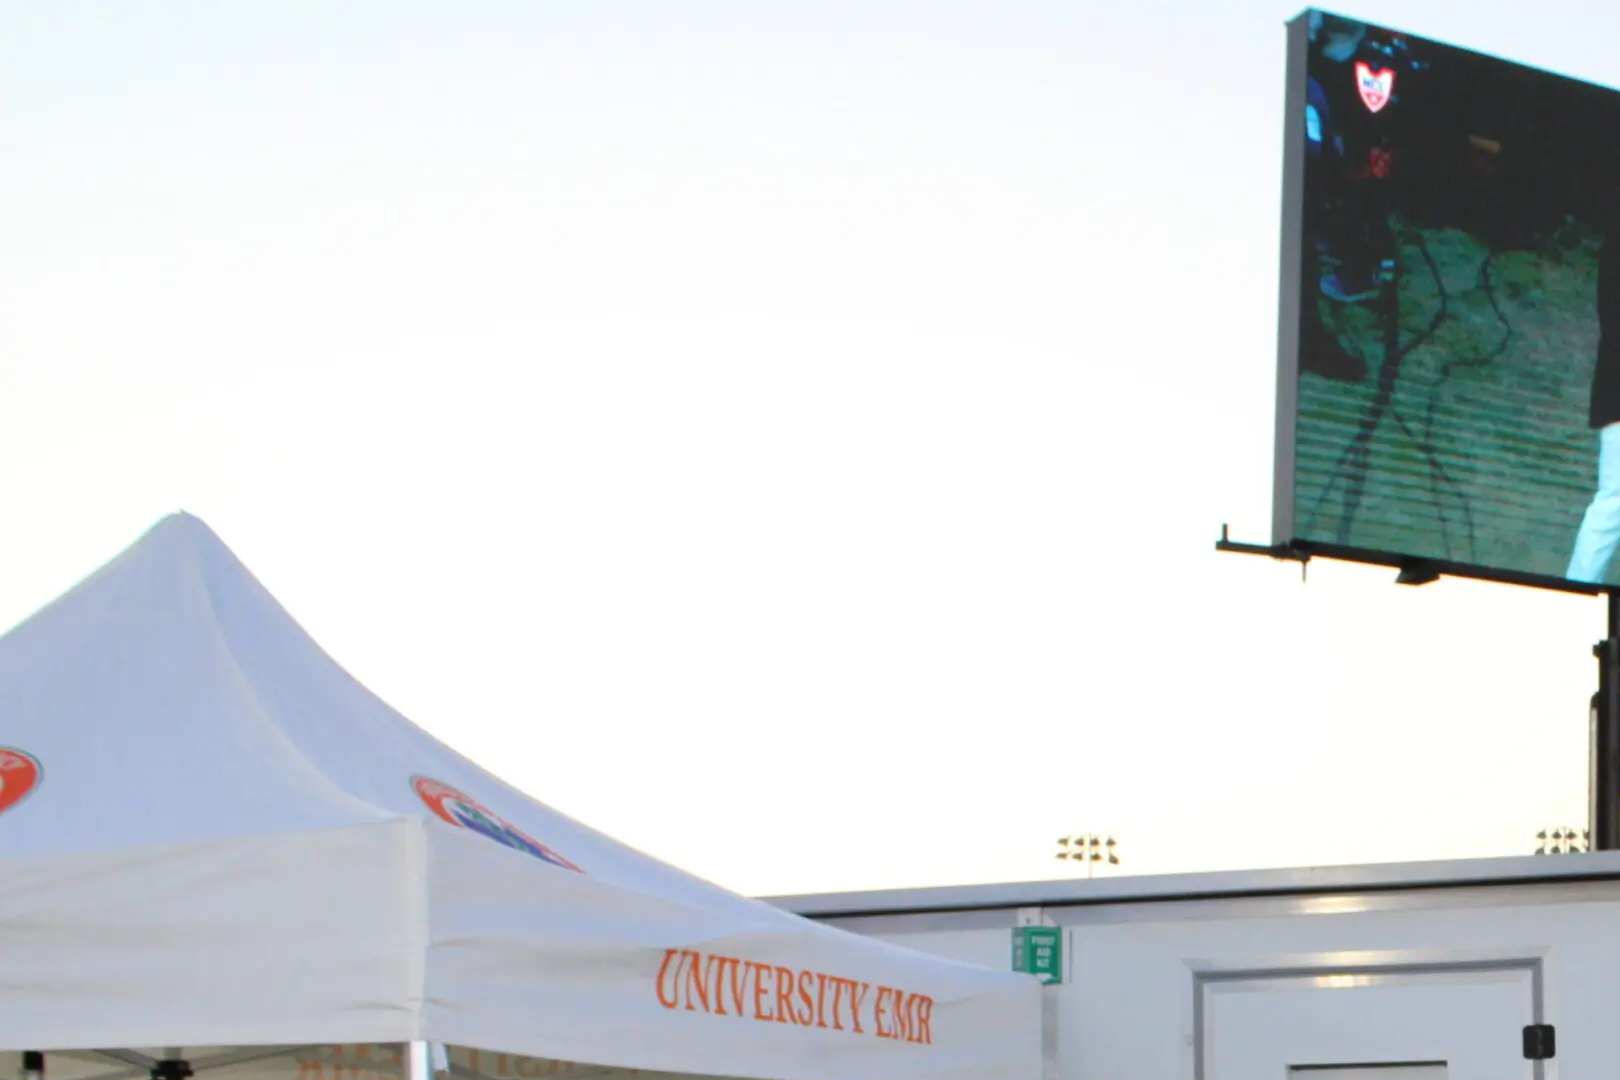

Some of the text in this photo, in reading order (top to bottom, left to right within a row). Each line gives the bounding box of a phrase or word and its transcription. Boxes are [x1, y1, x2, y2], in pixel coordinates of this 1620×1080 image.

[1031, 936, 1056, 946] FIRST
[1036, 947, 1052, 957] AID
[1036, 958, 1050, 968] KIT
[656, 948, 934, 1046] UNIVERSITY EMR
